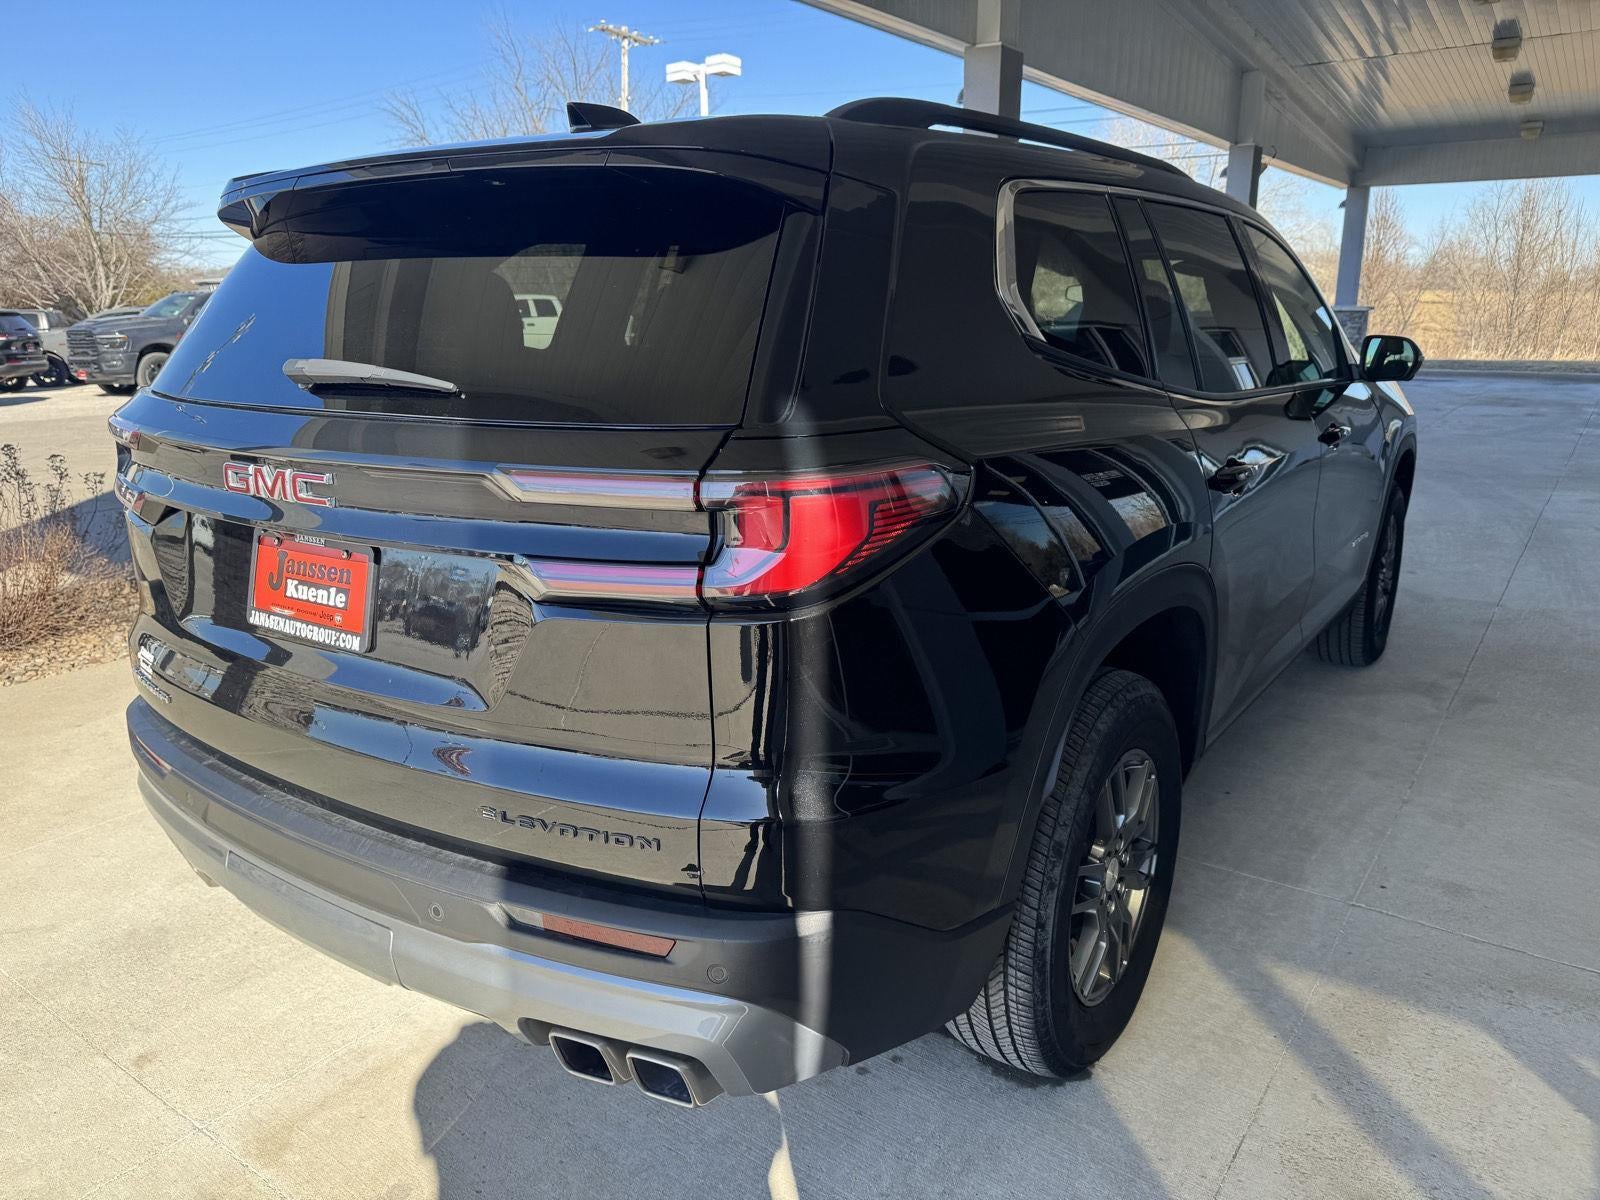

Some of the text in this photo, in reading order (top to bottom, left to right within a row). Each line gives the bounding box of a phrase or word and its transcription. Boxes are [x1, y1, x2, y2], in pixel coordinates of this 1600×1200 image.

[223, 462, 336, 508] GMC
[295, 533, 325, 545] JANSSEN
[268, 549, 352, 590] Janssen
[286, 579, 346, 608] Kuenle
[481, 805, 661, 851] ELEVATION
